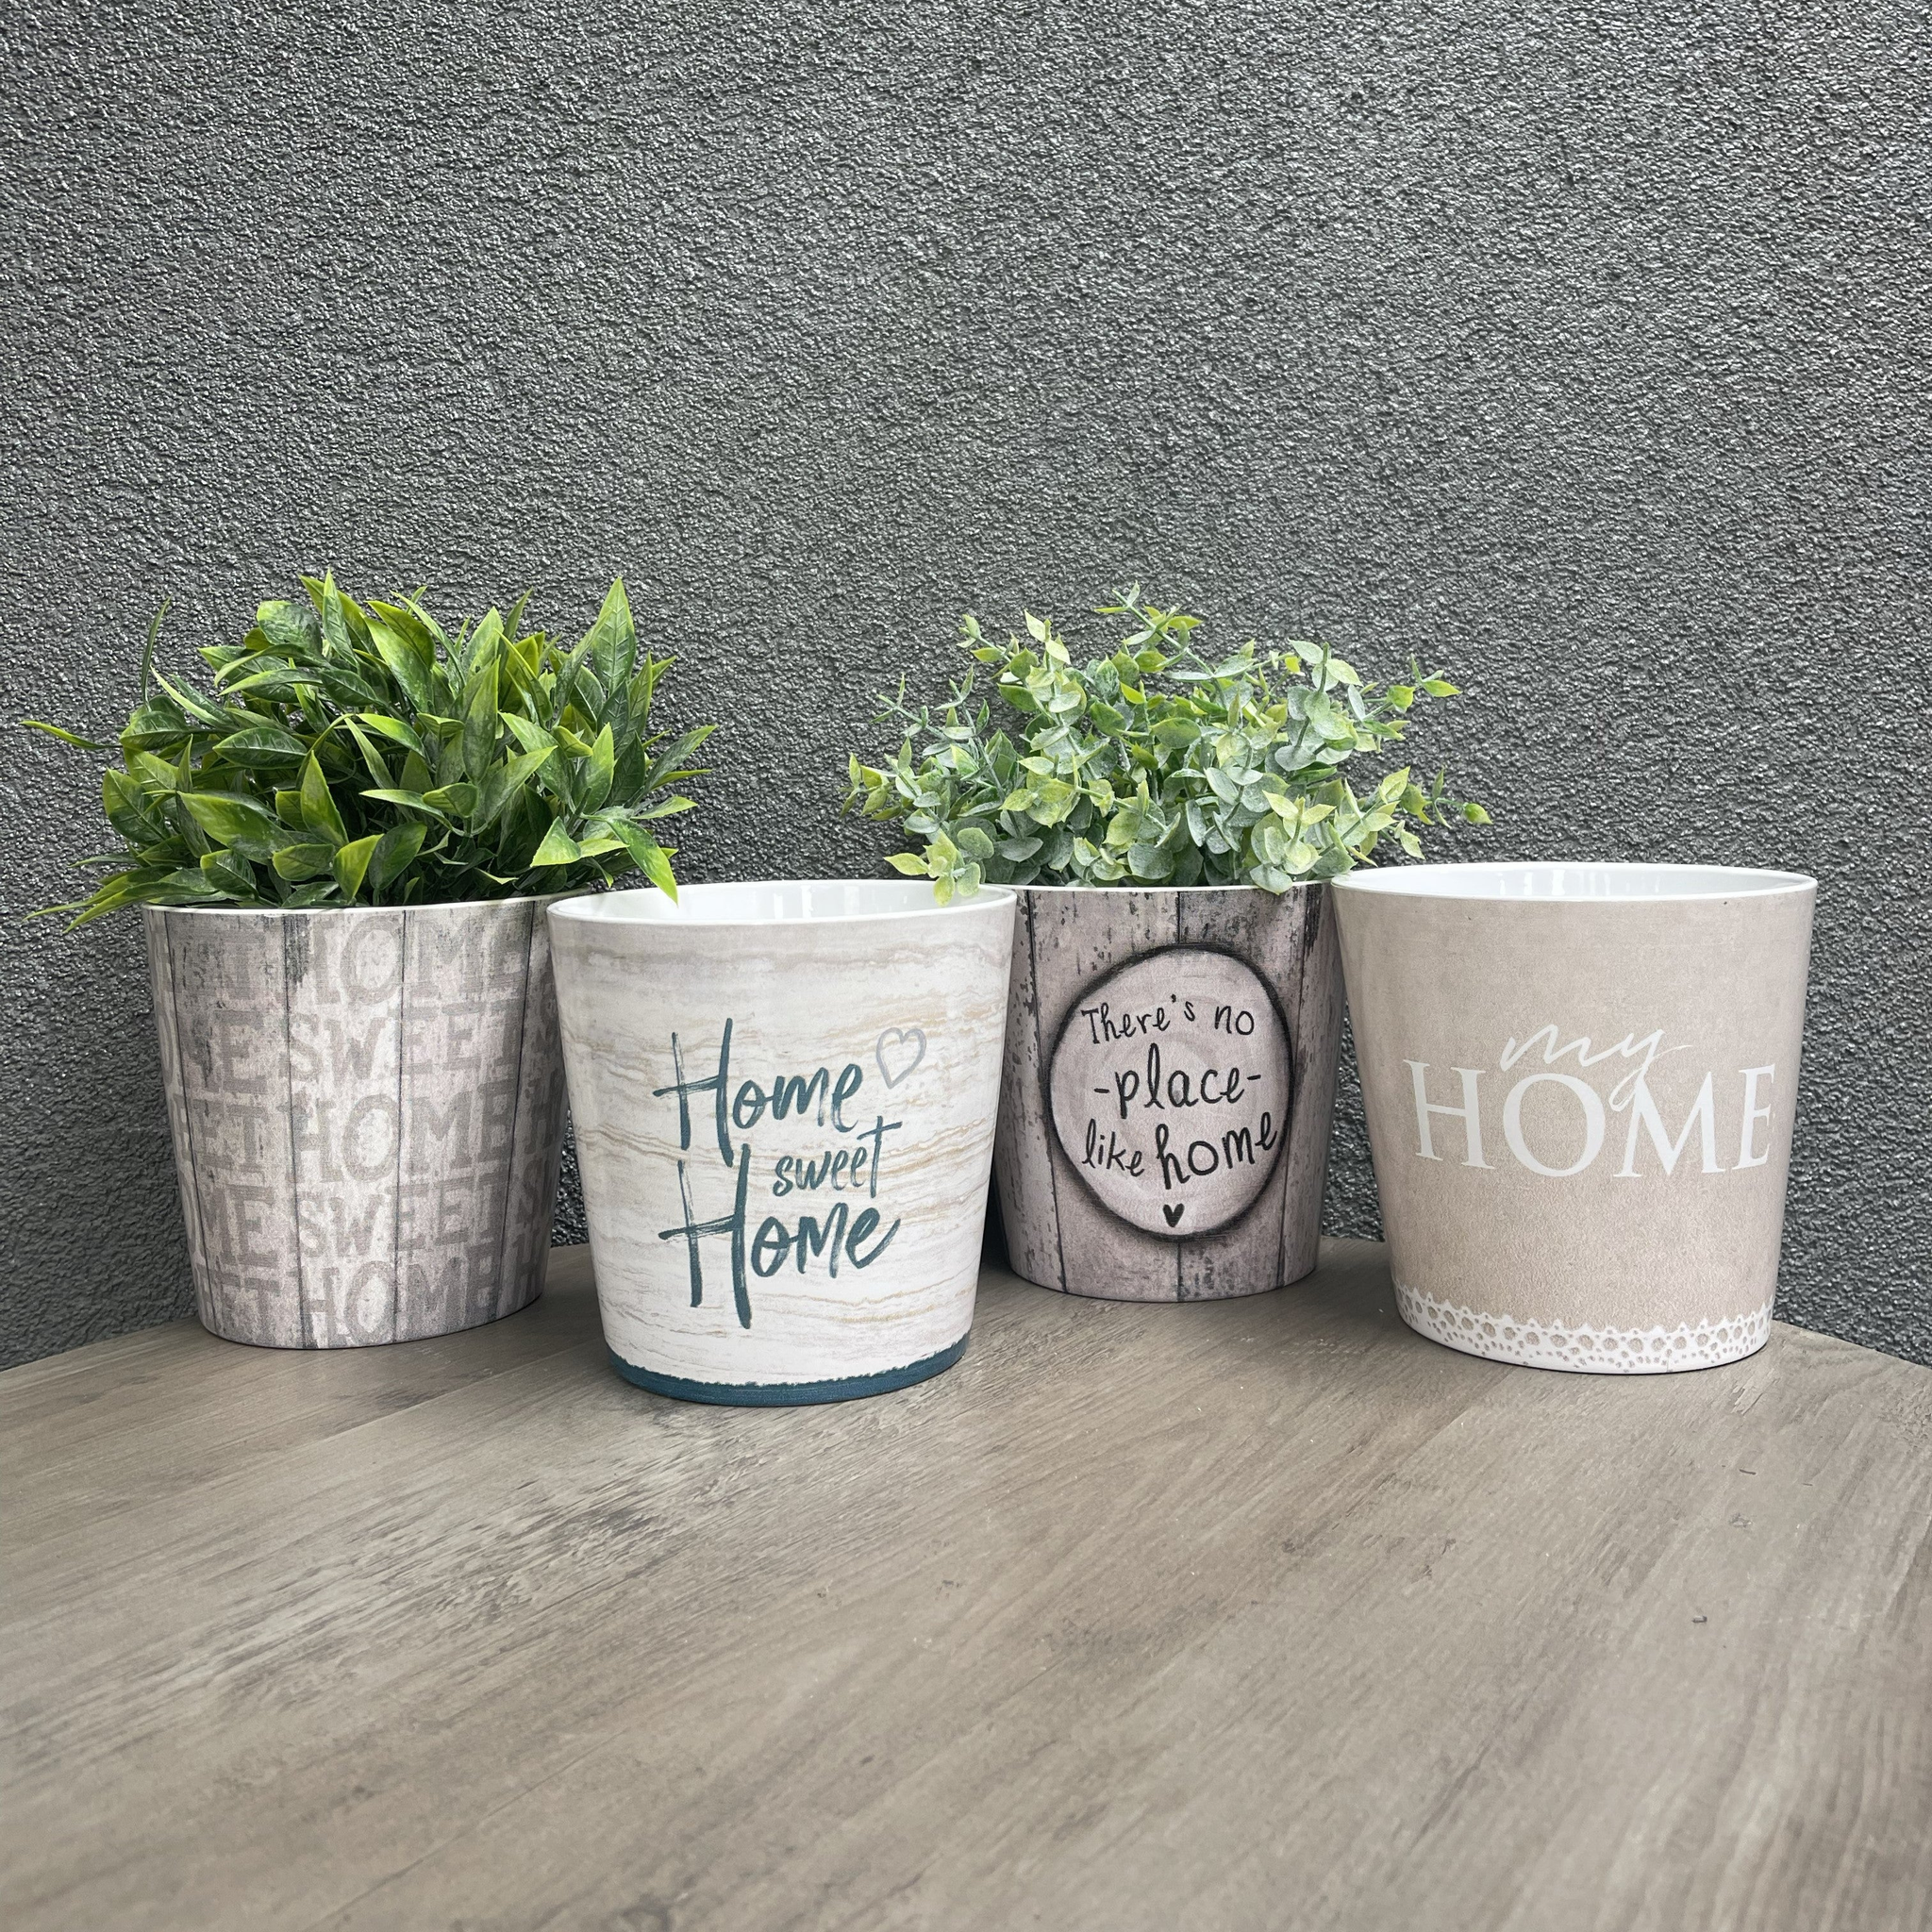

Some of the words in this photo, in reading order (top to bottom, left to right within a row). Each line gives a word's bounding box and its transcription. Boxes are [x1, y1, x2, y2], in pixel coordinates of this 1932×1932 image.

[280, 996, 525, 1083] SWEET
[1081, 994, 1195, 1044] There's
[1215, 1005, 1254, 1036] no
[653, 1018, 863, 1168] Home
[1500, 1024, 1693, 1112] my
[277, 1079, 522, 1184] HOME
[773, 1116, 903, 1199] sweet
[1082, 1119, 1145, 1177] like
[1156, 1111, 1277, 1190] home
[1403, 1058, 1775, 1178] HOME
[289, 1170, 512, 1260] SWEET
[658, 1143, 902, 1329] Home
[288, 1243, 505, 1348] HOME
